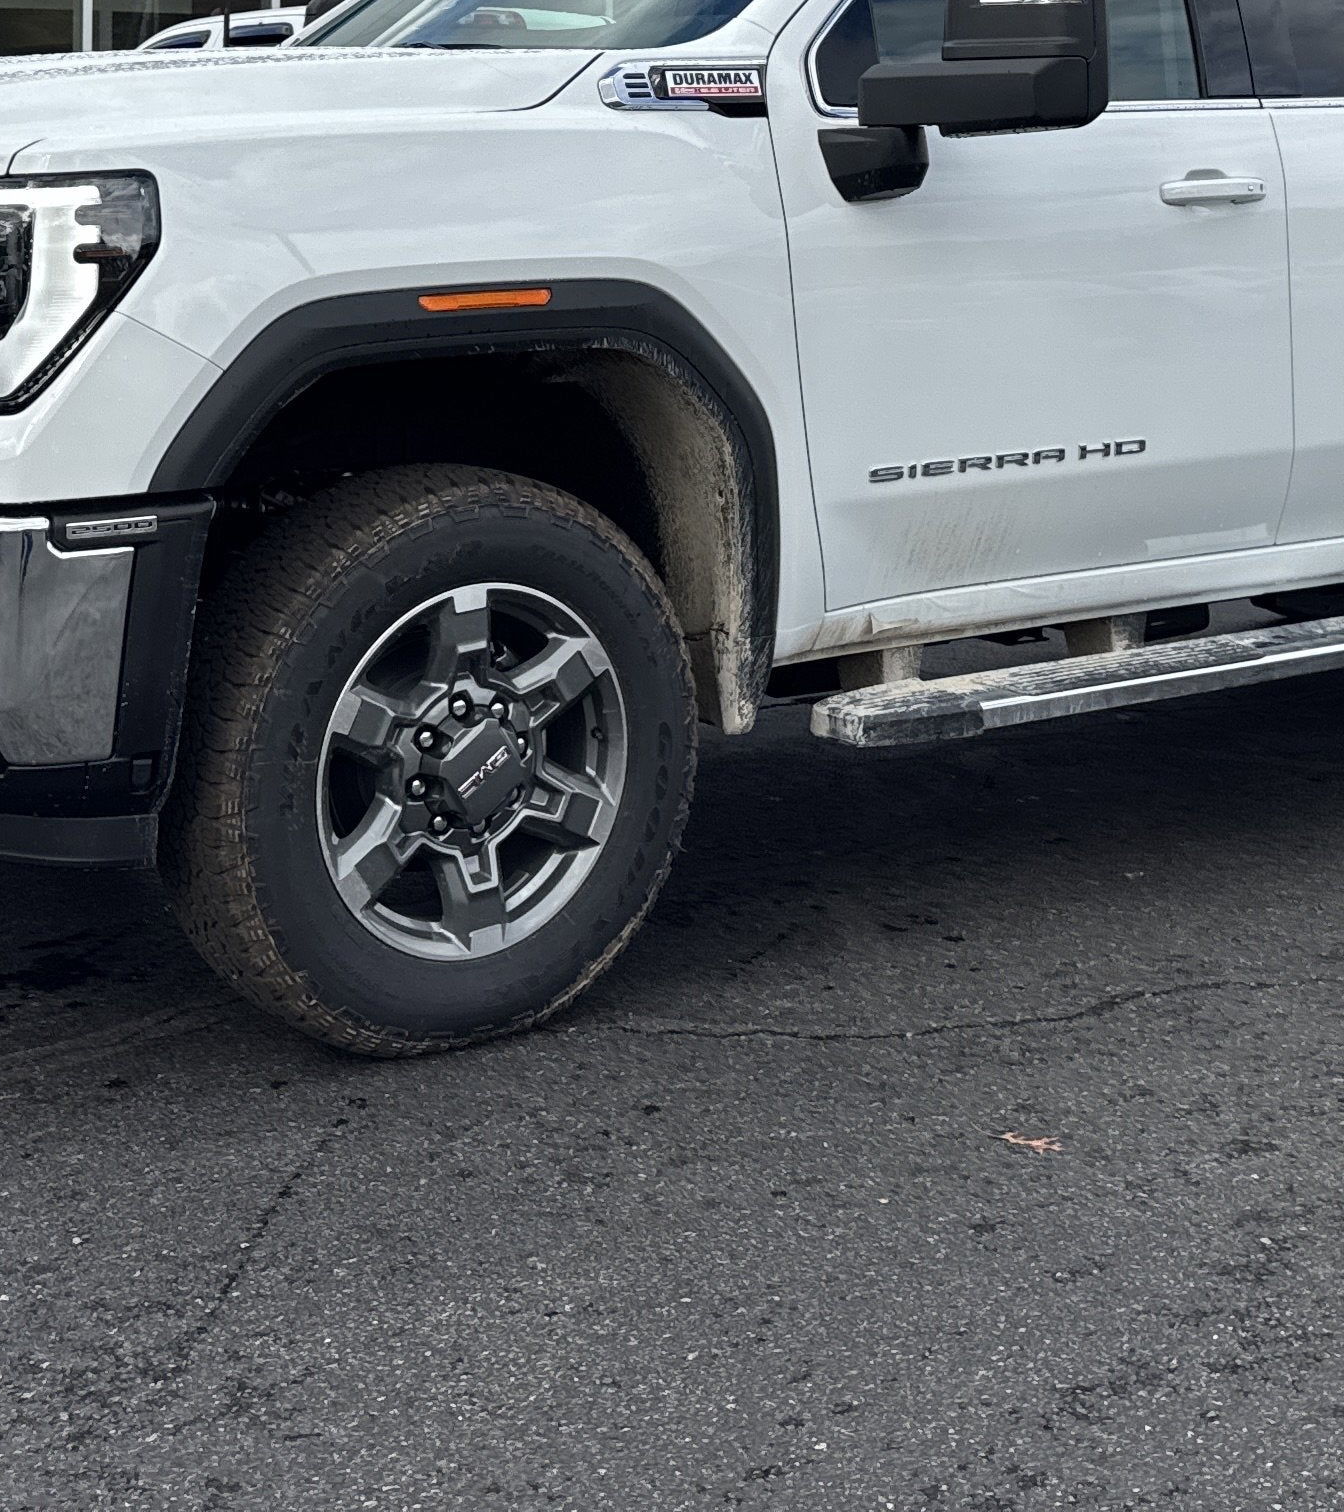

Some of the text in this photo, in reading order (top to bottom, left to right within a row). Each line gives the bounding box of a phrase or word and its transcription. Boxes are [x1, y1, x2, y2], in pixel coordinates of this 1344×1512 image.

[672, 72, 754, 85] DURAMAX
[867, 438, 1147, 484] SIERRA HD
[70, 519, 155, 536] 2500
[457, 745, 512, 800] GMC
